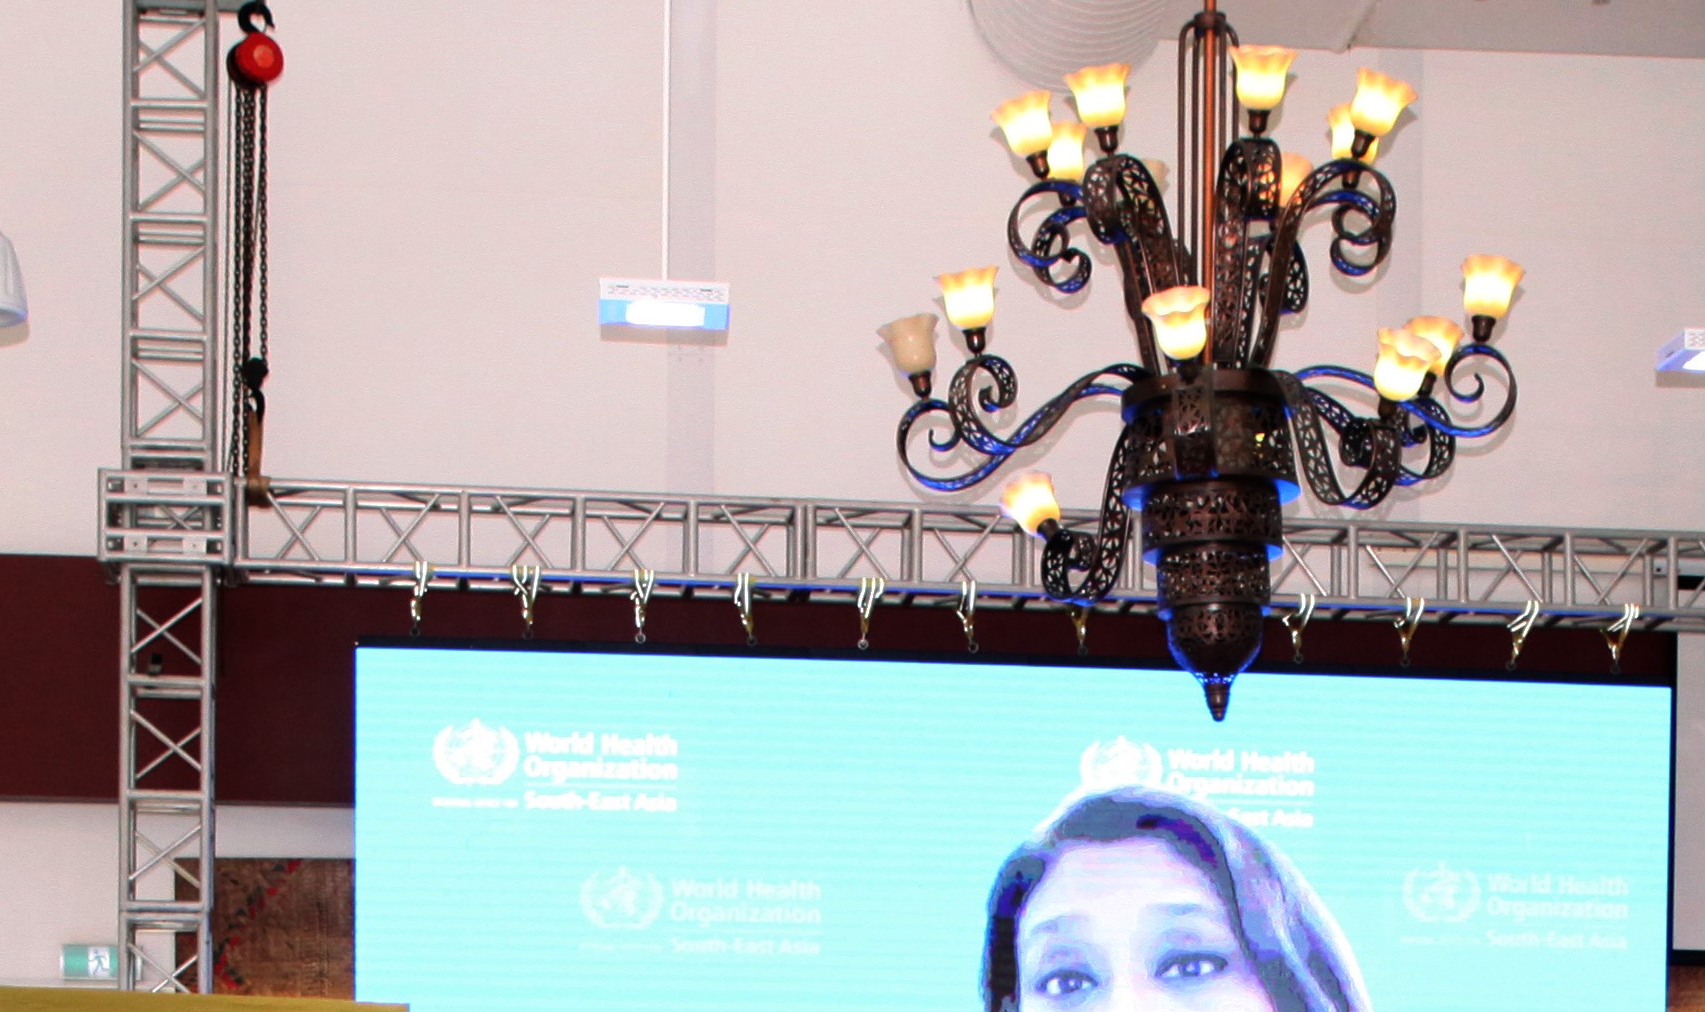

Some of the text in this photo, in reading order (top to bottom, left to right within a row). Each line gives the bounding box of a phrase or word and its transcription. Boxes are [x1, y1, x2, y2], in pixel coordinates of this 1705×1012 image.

[524, 731, 679, 756] World Health
[524, 756, 679, 784] Organization
[1167, 748, 1316, 773] World Health
[633, 793, 678, 812] Asia
[671, 878, 823, 900] World Health
[1486, 872, 1629, 896] World Health
[670, 901, 823, 928] Organization
[1486, 896, 1629, 922] Organization
